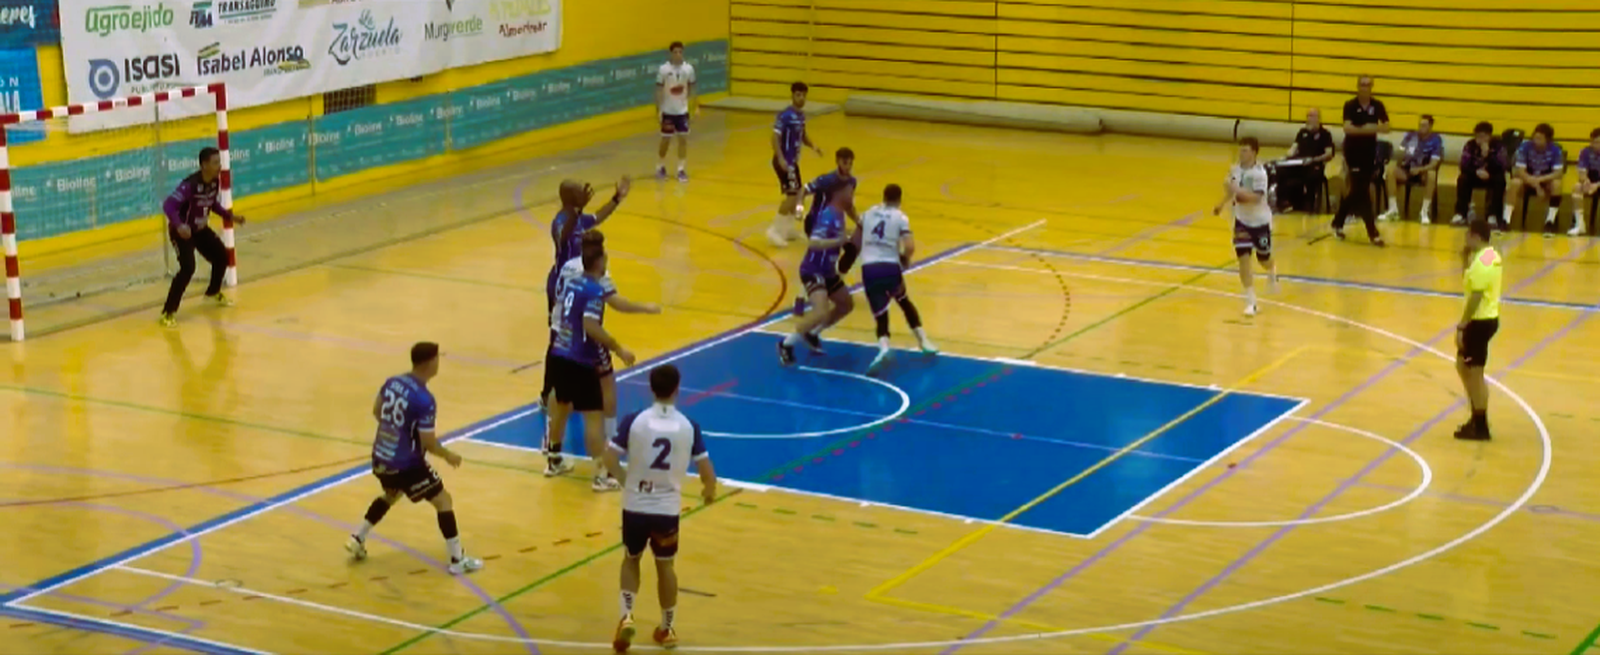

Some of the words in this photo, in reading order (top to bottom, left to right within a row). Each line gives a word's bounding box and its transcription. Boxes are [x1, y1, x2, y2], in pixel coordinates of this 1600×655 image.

[328, 16, 402, 66] Zarzuela
[197, 49, 246, 76] Isabel
[250, 45, 304, 67] Alonso
[871, 220, 885, 240] 4
[380, 387, 409, 428] 26
[649, 437, 672, 471] 2
